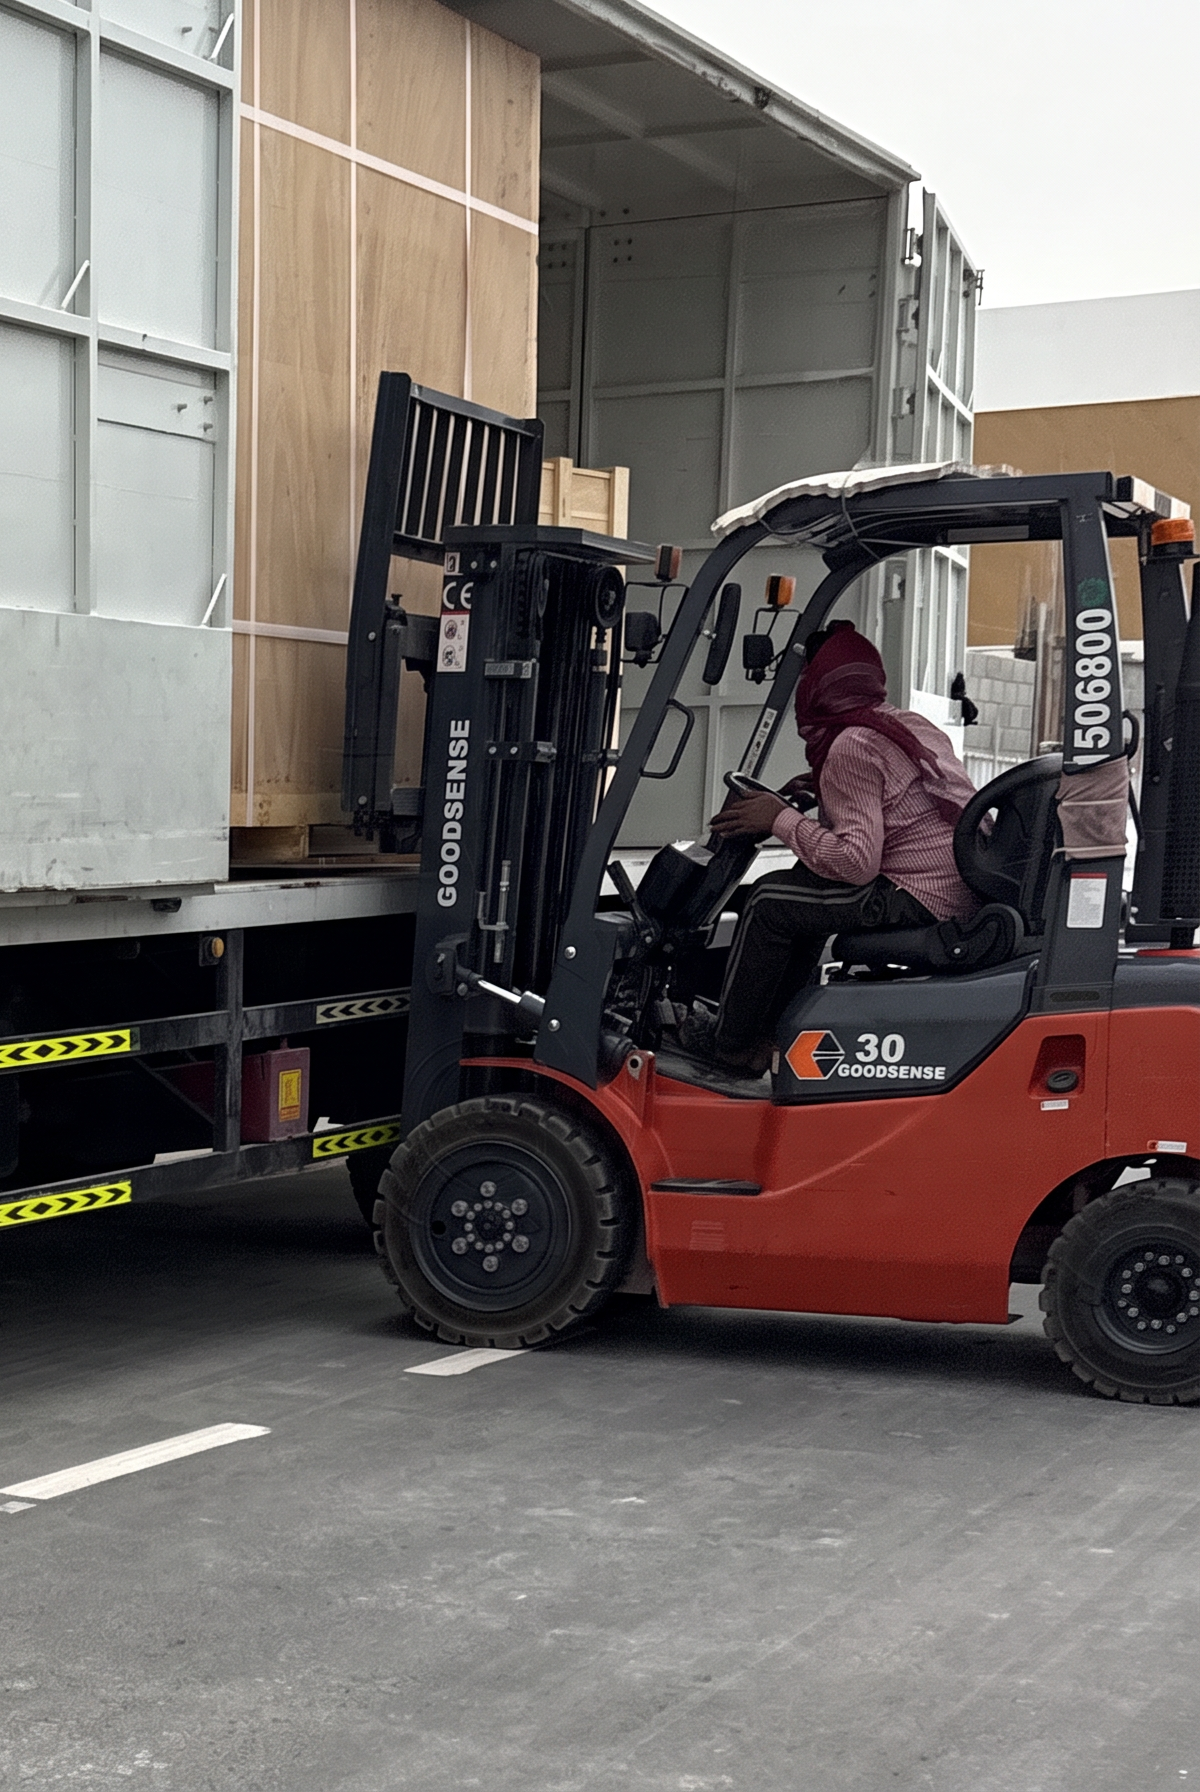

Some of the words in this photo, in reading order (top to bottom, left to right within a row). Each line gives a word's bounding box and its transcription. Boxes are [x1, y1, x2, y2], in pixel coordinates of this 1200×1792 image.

[442, 581, 474, 610] CE
[437, 719, 471, 908] GOODSENSE
[855, 1033, 905, 1063] 30
[837, 1063, 946, 1081] GOODSENSE
